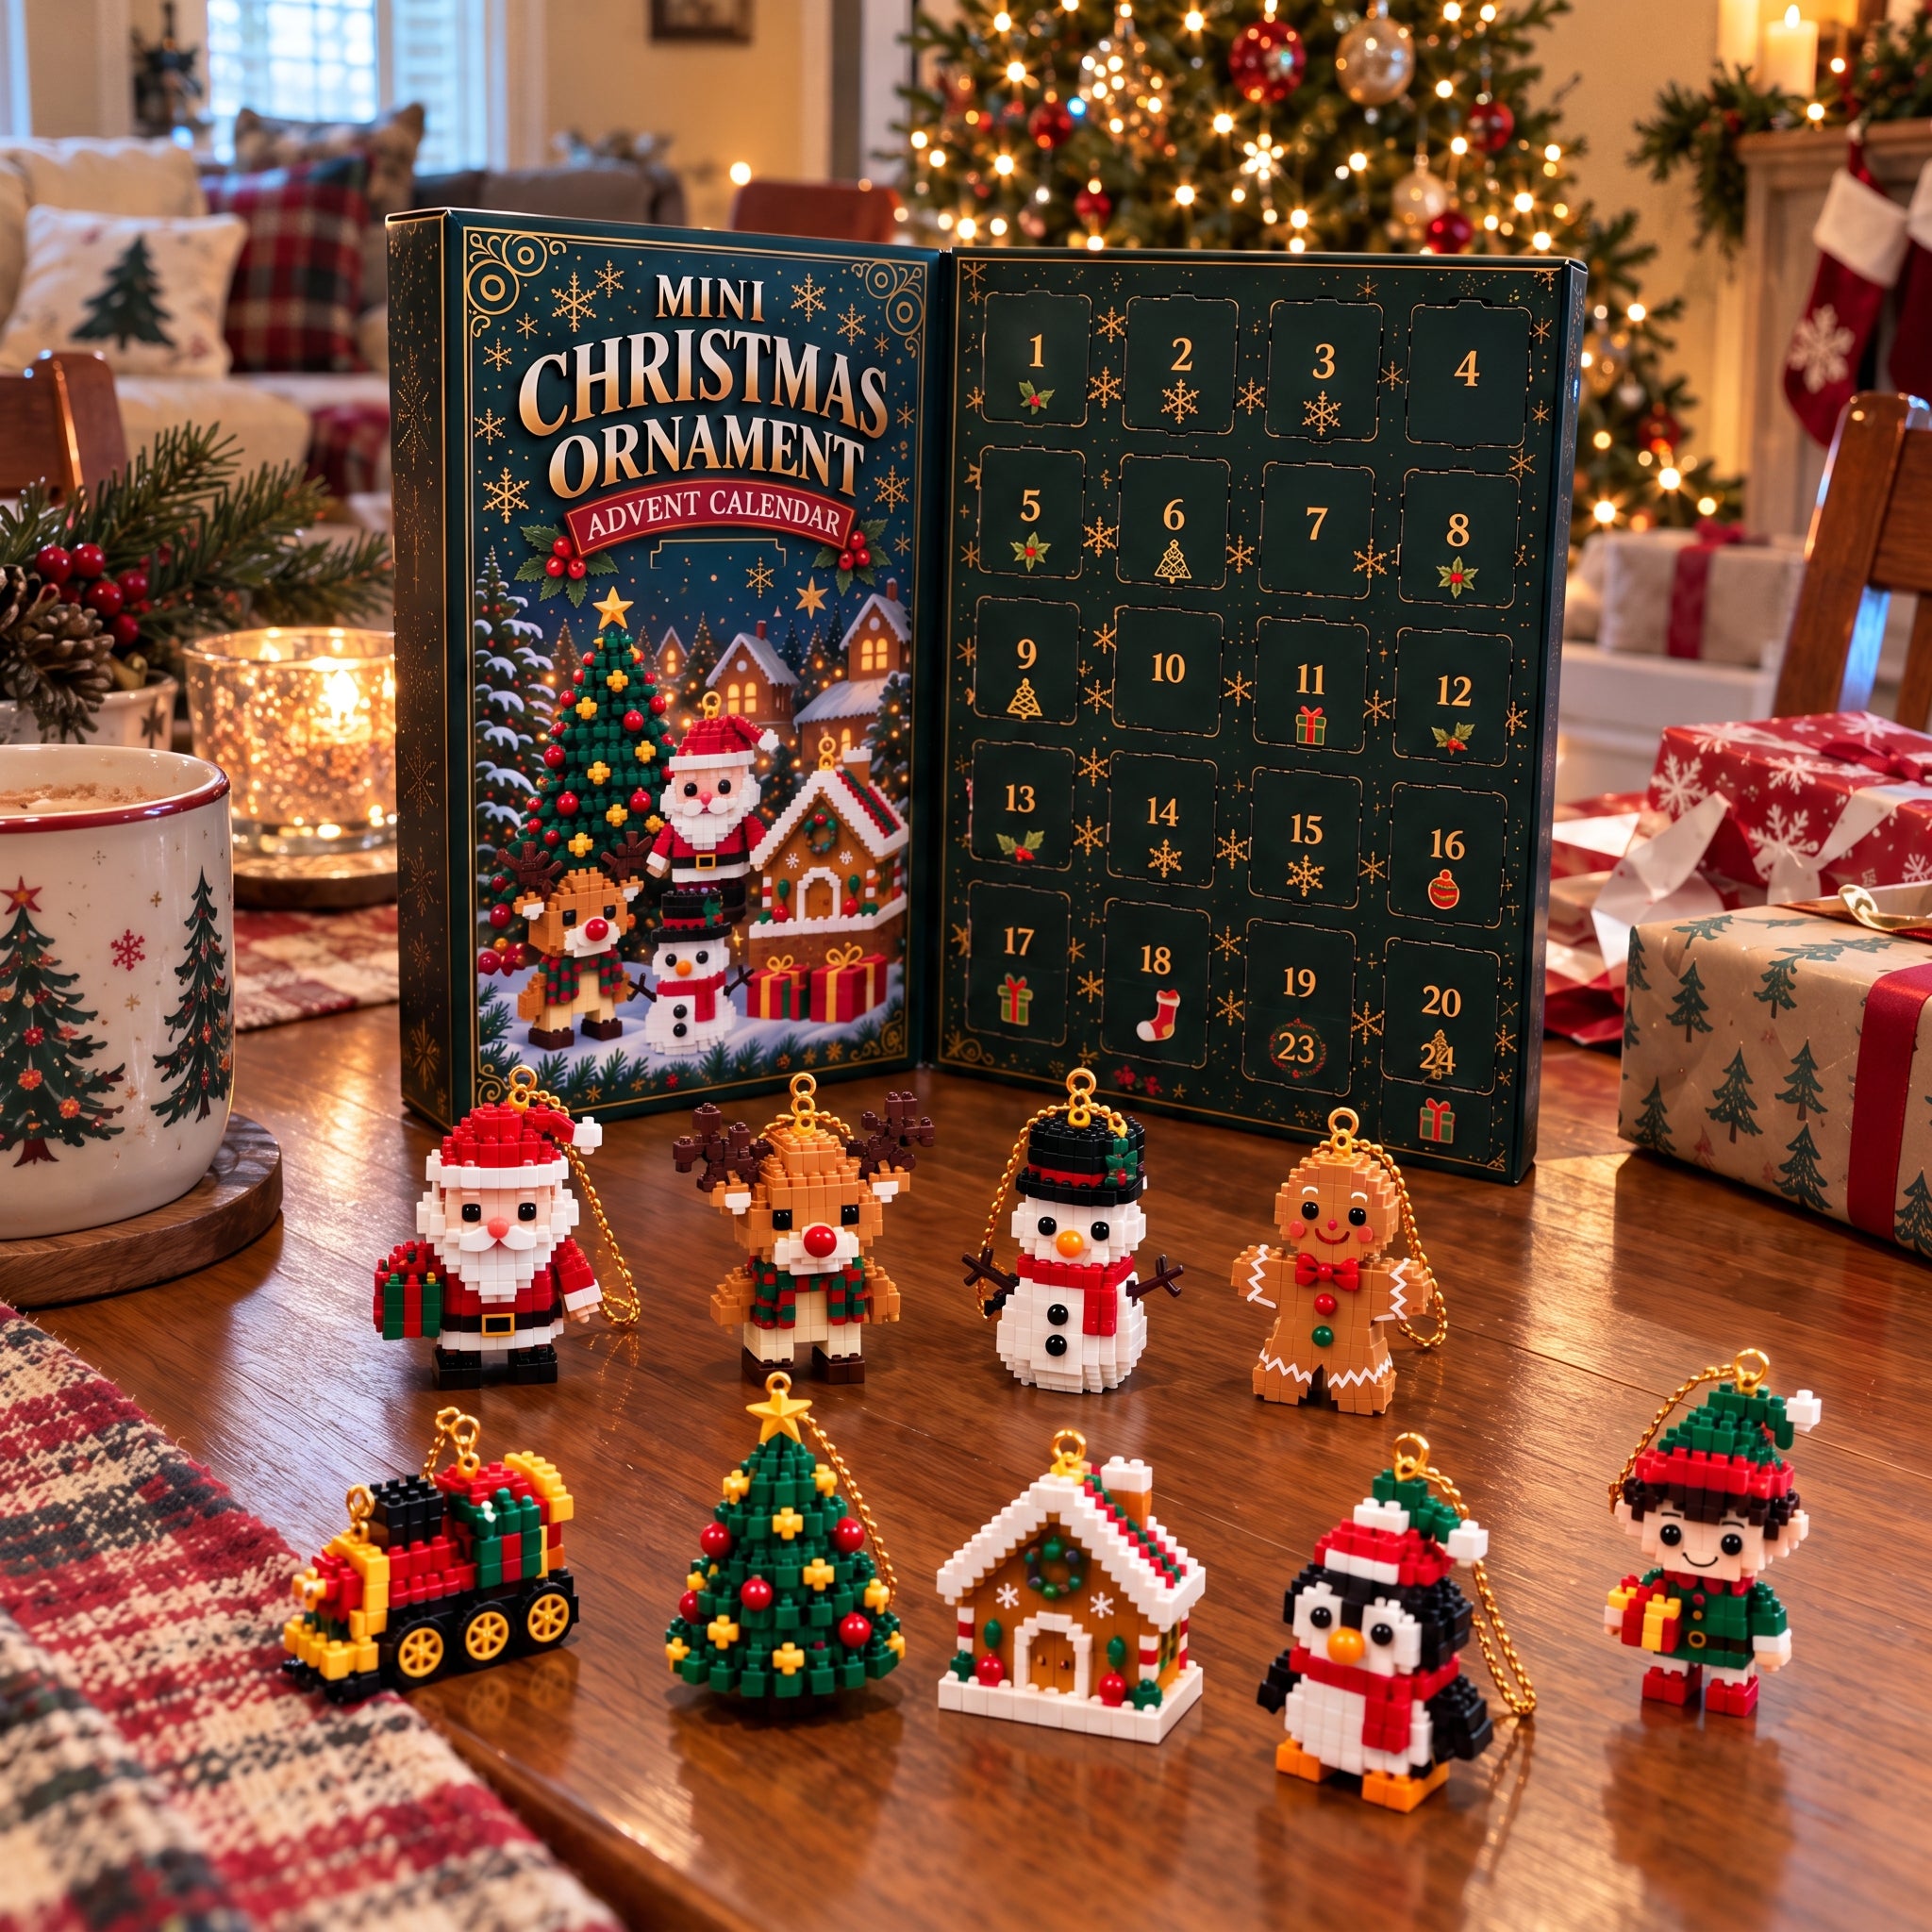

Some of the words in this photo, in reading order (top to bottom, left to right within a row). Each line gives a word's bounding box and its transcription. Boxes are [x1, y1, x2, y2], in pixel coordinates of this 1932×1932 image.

[656, 274, 765, 323] MINI
[1029, 333, 1044, 368] 1
[1170, 337, 1193, 372] 2
[1312, 342, 1336, 379] 3
[518, 328, 889, 440] CHRISTMAS
[1454, 350, 1480, 387] 4
[548, 414, 865, 499] ORNAMENT
[587, 491, 701, 541] ADVENT
[709, 490, 841, 537] CALENDAR
[1020, 489, 1041, 523] 5
[1163, 498, 1186, 531] 6
[1306, 507, 1329, 541] 7
[1446, 513, 1470, 547] 8
[1017, 638, 1038, 670] 9
[1151, 652, 1186, 684] 10
[1296, 663, 1325, 695] 11
[1436, 675, 1472, 708] 12
[1005, 784, 1036, 813] 13
[1146, 796, 1179, 827] 14
[1290, 813, 1324, 845] 15
[1430, 828, 1466, 860] 16
[1004, 926, 1035, 957] 17
[1141, 944, 1172, 975] 18
[1283, 967, 1317, 998] 19
[1421, 985, 1462, 1018] 20
[1277, 1031, 1315, 1063] 23
[1419, 1042, 1457, 1075] 24
